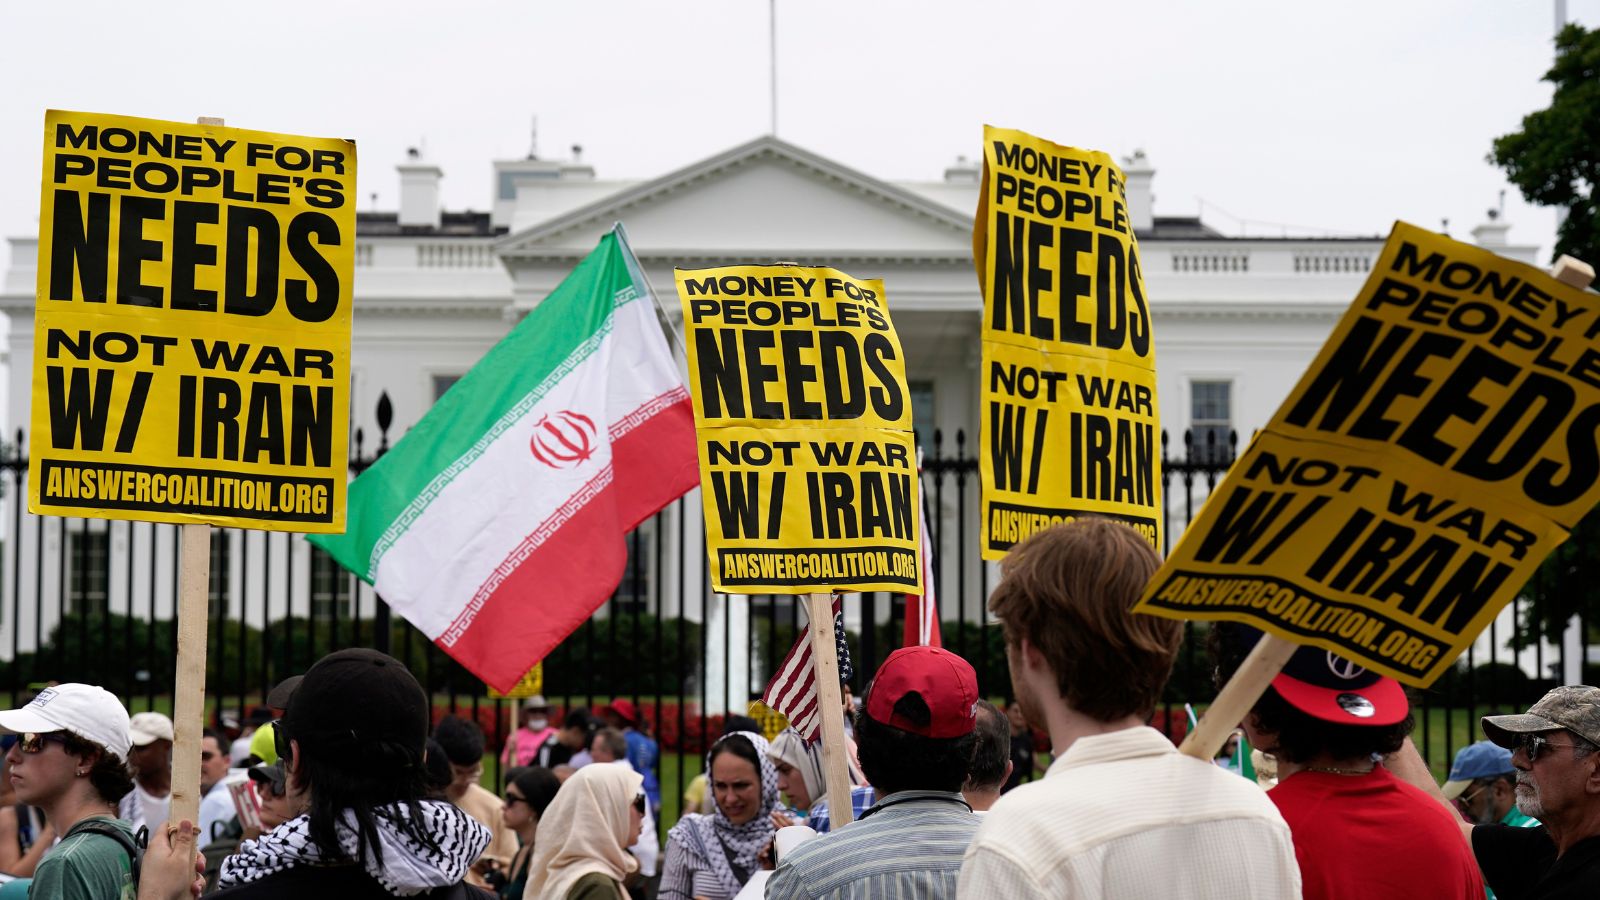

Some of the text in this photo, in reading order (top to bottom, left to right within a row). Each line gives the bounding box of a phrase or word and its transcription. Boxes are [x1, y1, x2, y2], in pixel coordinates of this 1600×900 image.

[54, 154, 345, 209] PEOPLE'S
[56, 123, 345, 175] MONEY FOR
[993, 141, 1102, 186] MONEY
[996, 172, 1134, 242] PEOPLE
[49, 190, 341, 323] NEEDS
[685, 276, 879, 307] MONEY FOR
[991, 211, 1150, 358] NEEDS
[1391, 242, 1588, 330] MONEY
[689, 299, 890, 331] PEOPLE'S
[47, 328, 334, 379] NOT WAR
[695, 328, 904, 422] NEEDS
[47, 366, 333, 468] W/ IRAN
[990, 361, 1153, 417] NOT WAR
[1284, 316, 1600, 507] NEEDS
[707, 440, 909, 469] NOT WAR
[990, 401, 1154, 508] W/ IRAN
[46, 467, 327, 514] ANSWERCOALITION.ORG
[710, 471, 786, 540] W/
[807, 471, 914, 541] IRAN
[1245, 452, 1538, 561] NOT WAR
[724, 551, 915, 580] ANSWERCOALITION.ORG
[1194, 485, 1514, 636] W/ IRAN
[1159, 575, 1440, 671] ANSWERCOALITION.ORG
